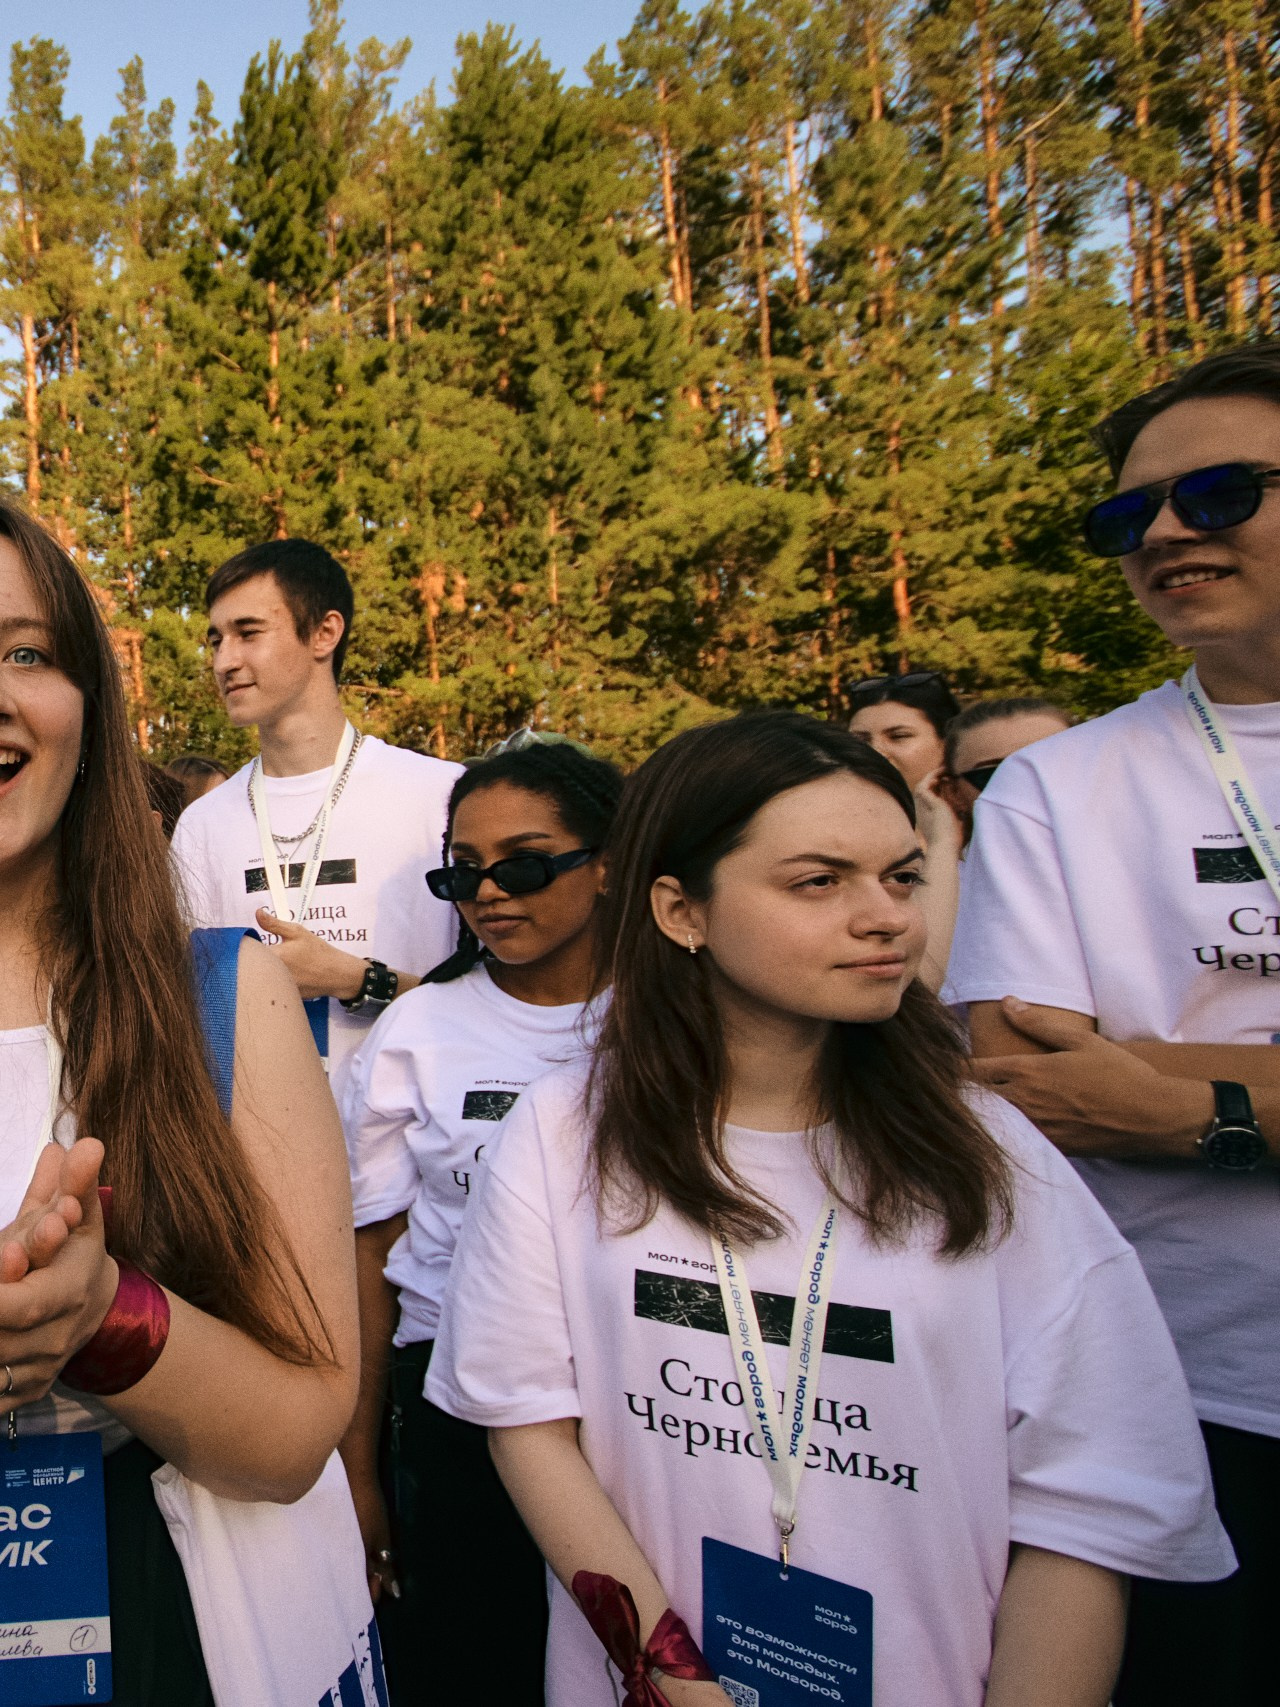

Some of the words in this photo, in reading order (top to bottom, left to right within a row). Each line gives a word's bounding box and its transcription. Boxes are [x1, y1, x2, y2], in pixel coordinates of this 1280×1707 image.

[822, 1209, 835, 1239] мол
[648, 1252, 678, 1263] мол
[691, 1261, 717, 1273] гор
[808, 1252, 825, 1304] город
[730, 1283, 749, 1347] меняет
[799, 1307, 815, 1373] меняет
[742, 1350, 764, 1409] город
[624, 1392, 919, 1493] Черноемья
[760, 1424, 778, 1461] мол
[789, 1375, 807, 1458] молодых
[33, 1477, 64, 1486] ЦЕНТР
[814, 1615, 857, 1634] город
[815, 1605, 841, 1619] мол
[716, 1615, 742, 1630] это
[745, 1626, 857, 1675] возможности
[731, 1634, 759, 1652] для
[763, 1648, 840, 1685] молодых.
[727, 1649, 753, 1664] это
[757, 1659, 845, 1702] Молгород.
